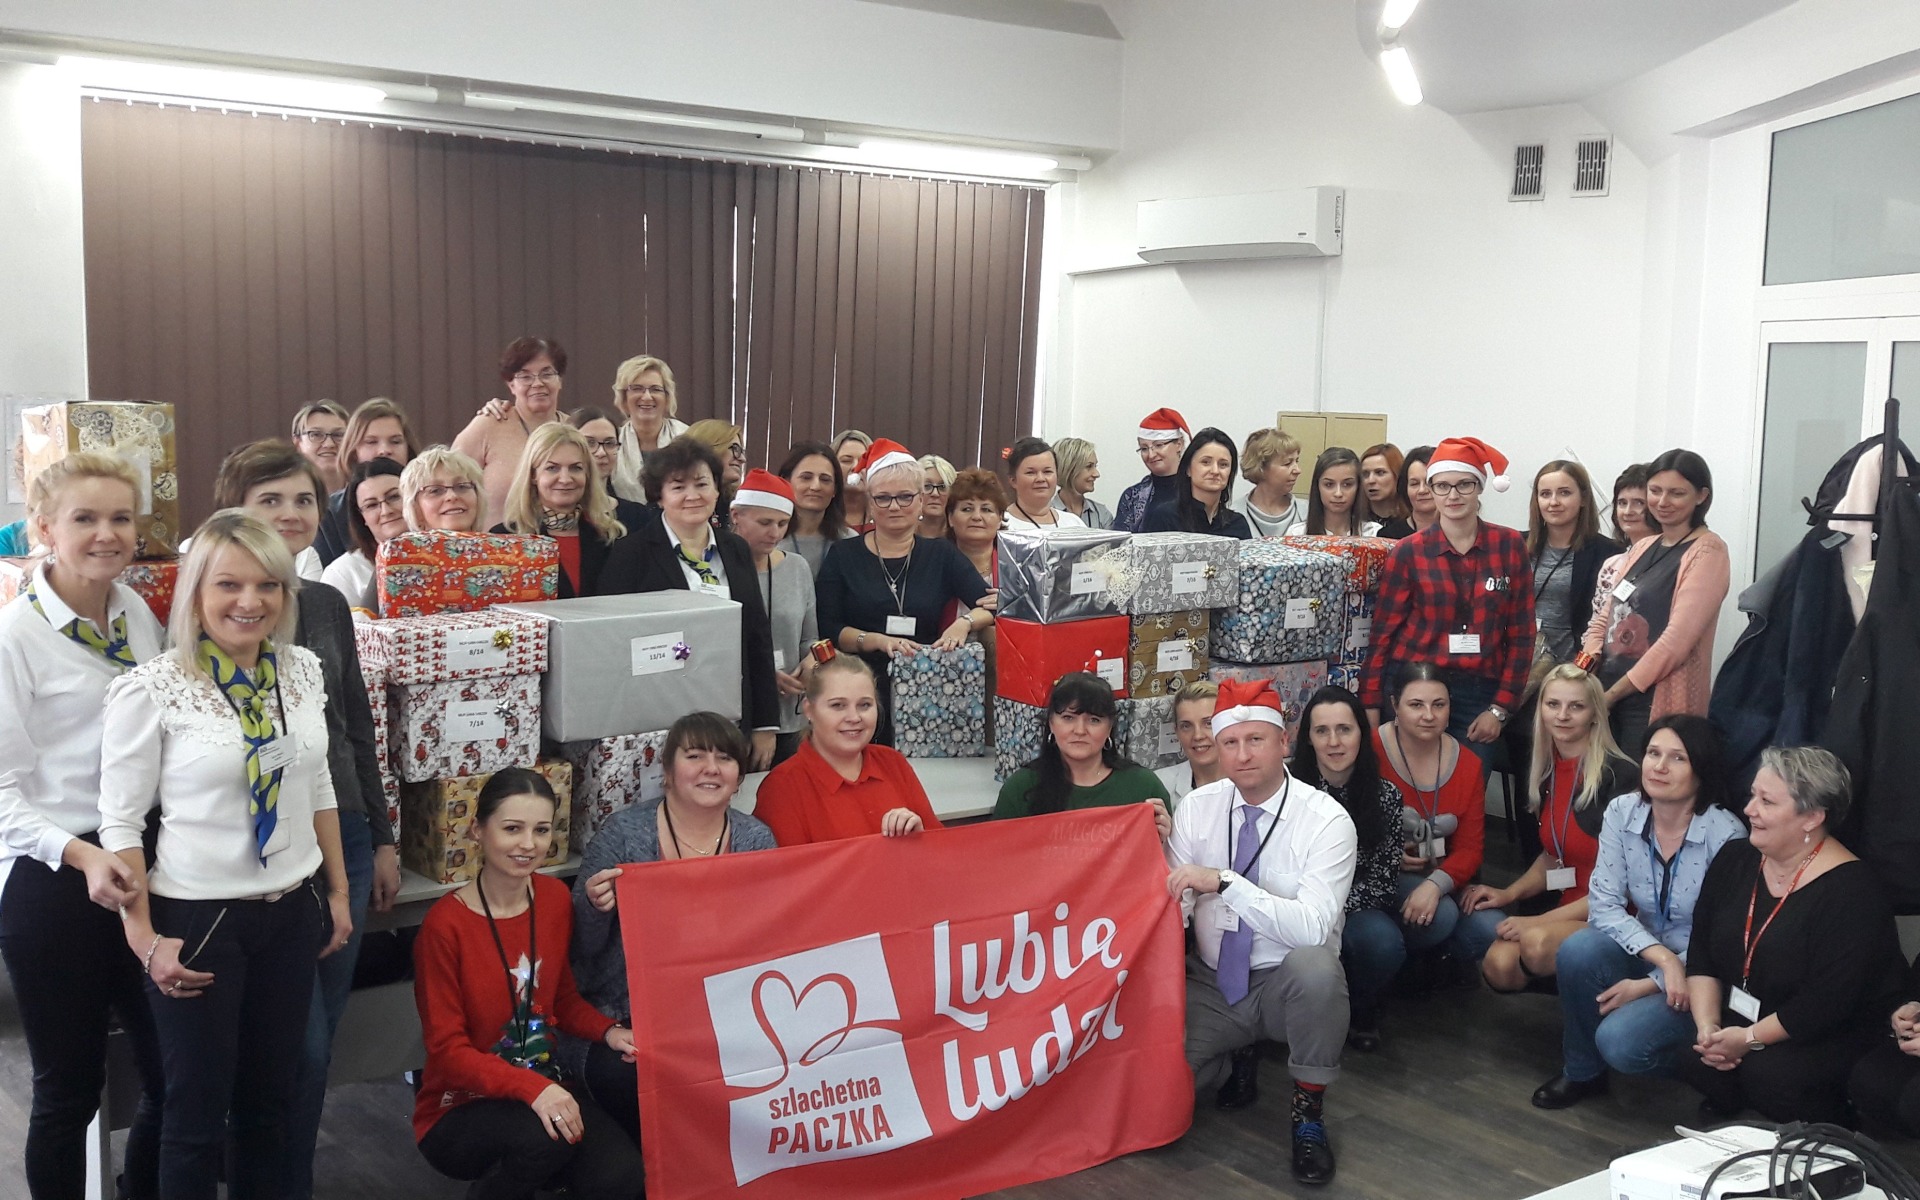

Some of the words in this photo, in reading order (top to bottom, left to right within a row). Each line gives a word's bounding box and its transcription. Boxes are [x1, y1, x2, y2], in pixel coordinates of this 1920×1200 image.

[469, 648, 484, 656] 8/14
[469, 720, 484, 728] 7/14
[933, 902, 1122, 1031] Lubię
[942, 970, 1128, 1122] ludzi
[768, 1073, 882, 1120] szlachetna
[767, 1105, 894, 1155] PACZKA
